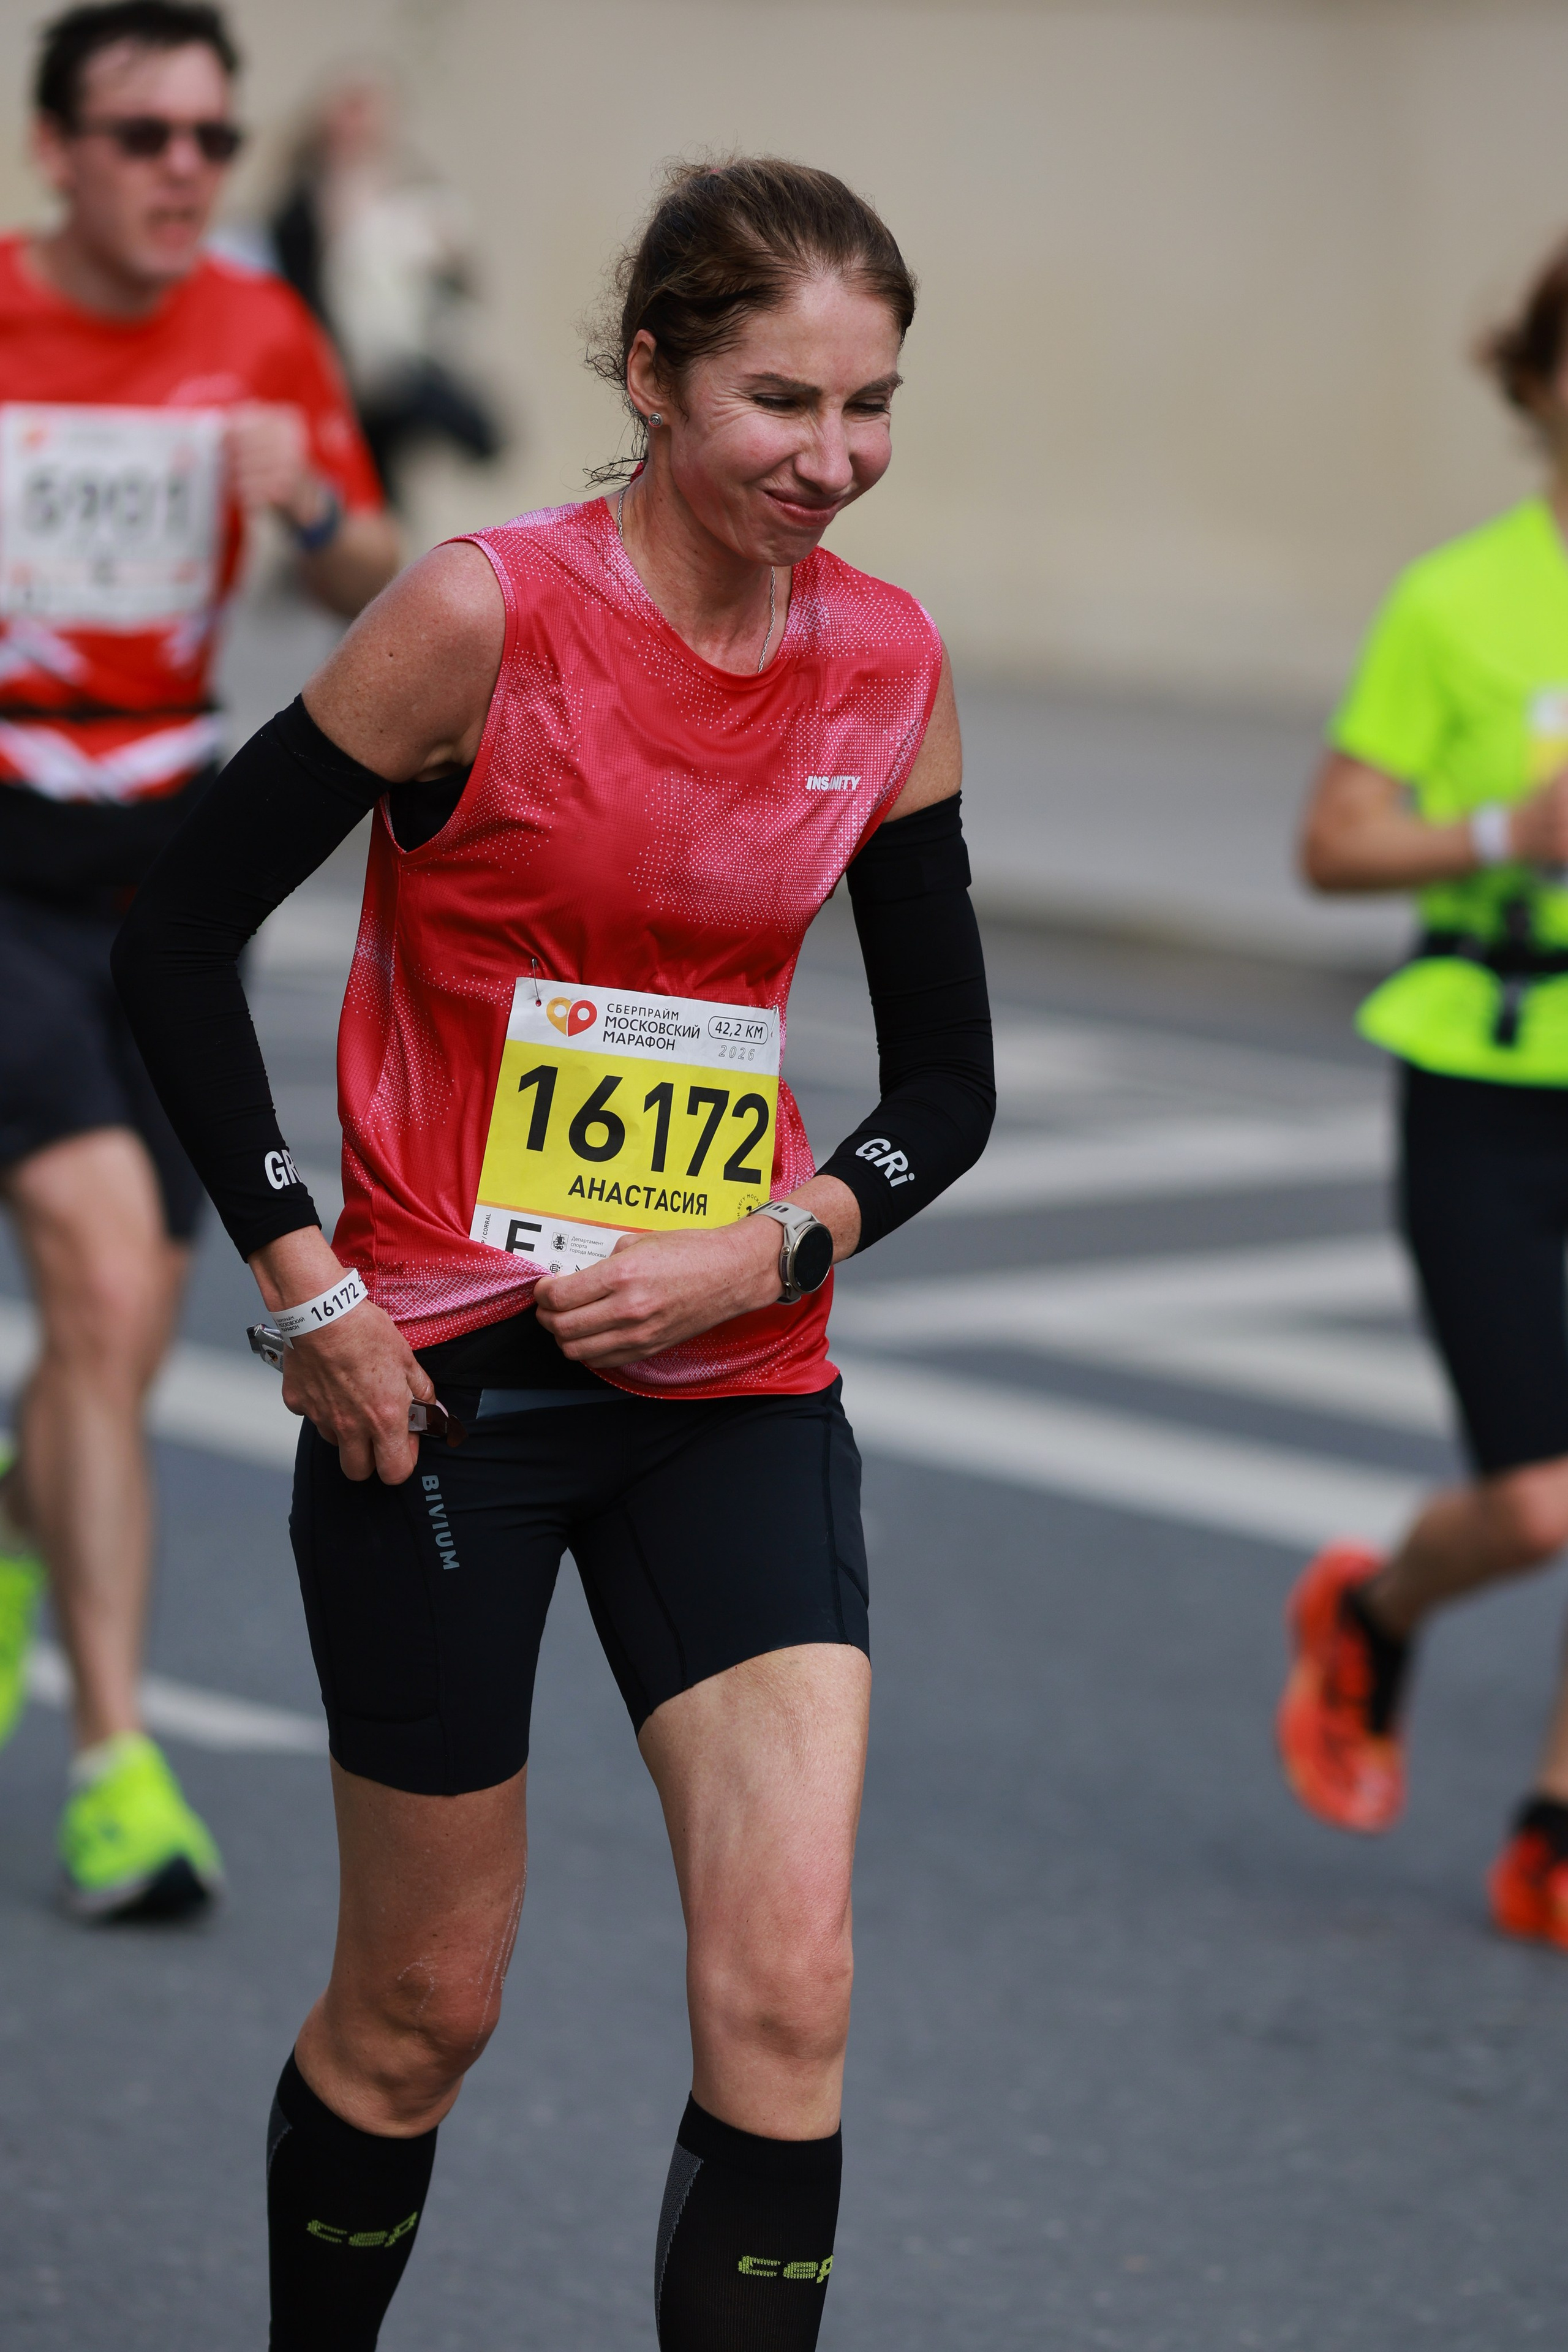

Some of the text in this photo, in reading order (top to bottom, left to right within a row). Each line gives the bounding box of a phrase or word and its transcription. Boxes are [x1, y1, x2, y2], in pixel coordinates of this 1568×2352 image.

[606, 1003, 680, 1021] СБЕРПРАЙМ
[605, 1016, 701, 1039] МОСКОВСКИЙ
[715, 1021, 763, 1039] 42,2 КМ
[603, 1030, 676, 1051] МАРАФОН
[718, 1045, 755, 1061] 2026
[518, 1065, 770, 1185] 16172
[855, 1138, 915, 1188] GRi
[568, 1175, 707, 1216] АНАСТАСИЯ
[747, 1194, 761, 1206] МОСКО
[483, 1213, 491, 1235] CORRAL
[571, 1236, 604, 1246] Департамент
[311, 1282, 360, 1322] 16172
[421, 1475, 460, 1570] BIVIUM
